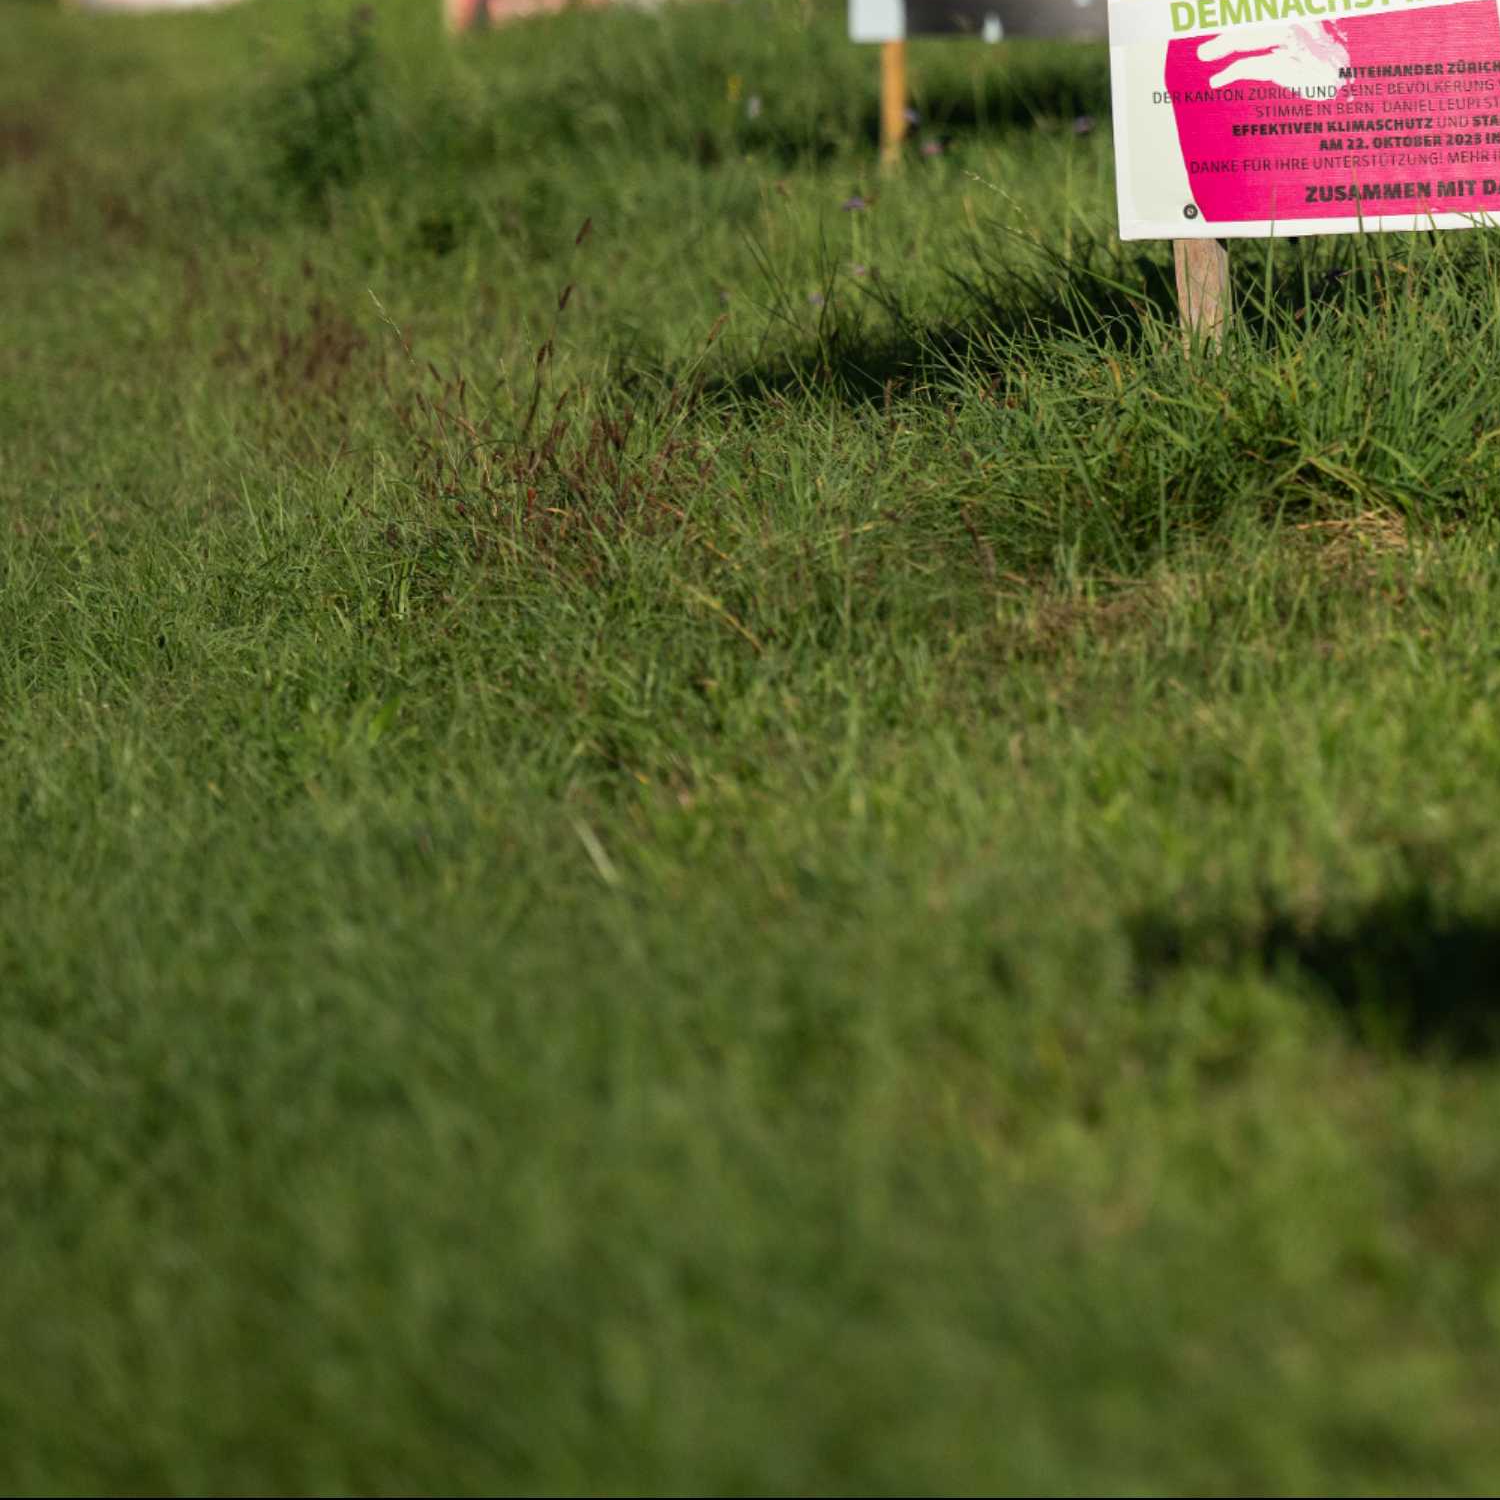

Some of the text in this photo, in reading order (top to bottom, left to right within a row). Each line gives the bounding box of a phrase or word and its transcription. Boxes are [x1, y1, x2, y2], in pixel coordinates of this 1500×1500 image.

[1338, 62, 1444, 79] MITEINANDER
[1152, 90, 1181, 104] DER
[1184, 88, 1243, 102] KANTON
[1305, 84, 1337, 98] UND
[1340, 82, 1383, 97] SEINE
[1255, 103, 1313, 118] STIMME
[1317, 102, 1332, 116] IN
[1383, 99, 1435, 113] DANIEL
[1439, 96, 1479, 111] LEUPI
[1232, 121, 1323, 136] EFFEKTIVEN
[1327, 117, 1433, 133] KLIMASCHUTZ
[1437, 115, 1468, 129] UND
[1319, 139, 1343, 151] AM
[1372, 134, 1442, 149] OKTOBER
[1446, 133, 1482, 147] 2023
[1190, 159, 1239, 174] DANKE
[1275, 157, 1309, 171] IHRE
[1447, 150, 1489, 164] MEHR
[1305, 181, 1432, 203] ZUSAMMEN
[1437, 179, 1477, 197] MIT
